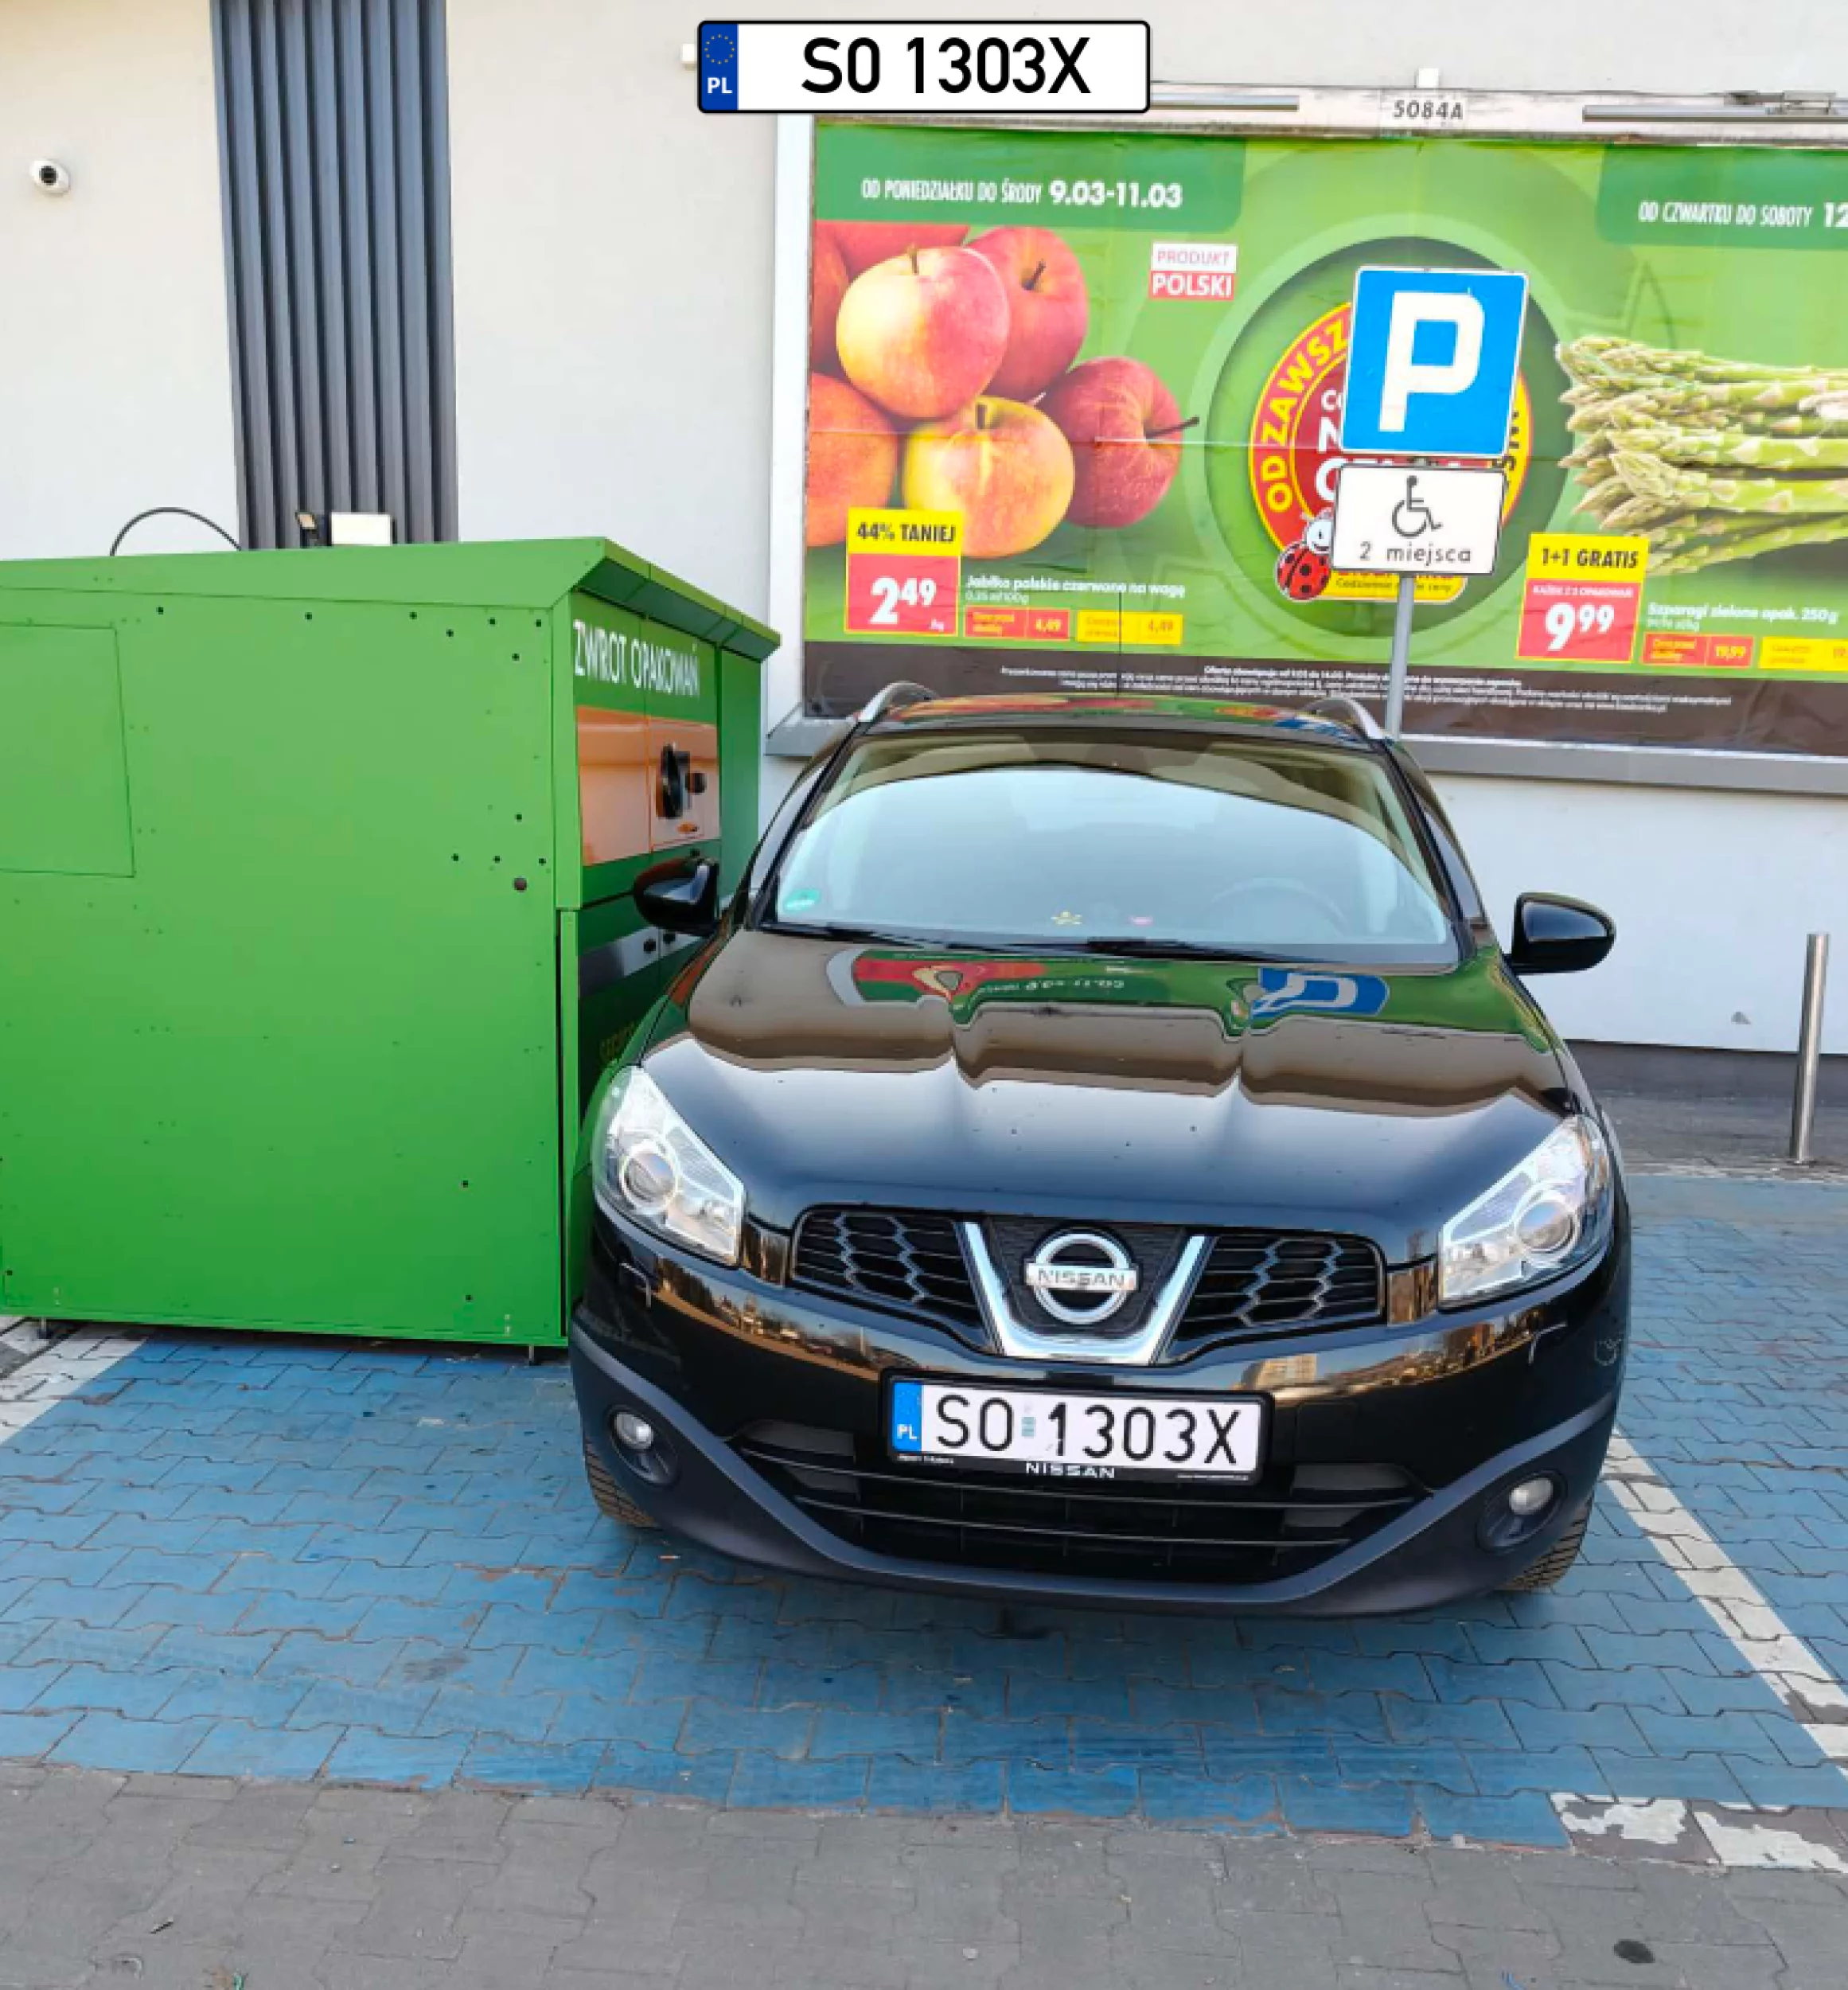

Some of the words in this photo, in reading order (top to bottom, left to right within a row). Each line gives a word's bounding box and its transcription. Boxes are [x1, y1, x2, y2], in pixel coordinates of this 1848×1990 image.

[1391, 100, 1464, 120] 5084A
[861, 178, 881, 198] OD
[977, 181, 998, 201] DO
[1000, 177, 1043, 204] ŚRODY
[1047, 180, 1183, 209] 9.03-11.03
[1638, 201, 1659, 224] OD
[1735, 204, 1756, 225] DO
[1760, 205, 1814, 228] SOBOTY
[1157, 249, 1230, 267] PRODUKT
[1152, 273, 1233, 298] POLSKI
[1378, 291, 1486, 432] P
[1260, 318, 1349, 448] ZAWSZ
[1260, 455, 1293, 514] OD
[856, 521, 896, 541] 44%
[900, 523, 957, 544] TANIEJ
[1359, 540, 1373, 562] 2
[1386, 540, 1472, 567] miejsca
[1541, 547, 1571, 567] 1+1
[1576, 548, 1640, 570] GRATIS
[573, 618, 627, 685] ZWROT
[630, 638, 700, 700] OPAKOWAŃ
[1038, 1266, 1125, 1287] NISSAN
[896, 1423, 918, 1441] PL
[935, 1394, 1014, 1452] SO
[1047, 1401, 1241, 1465] 1303X
[1025, 1461, 1116, 1479] NISSAN
